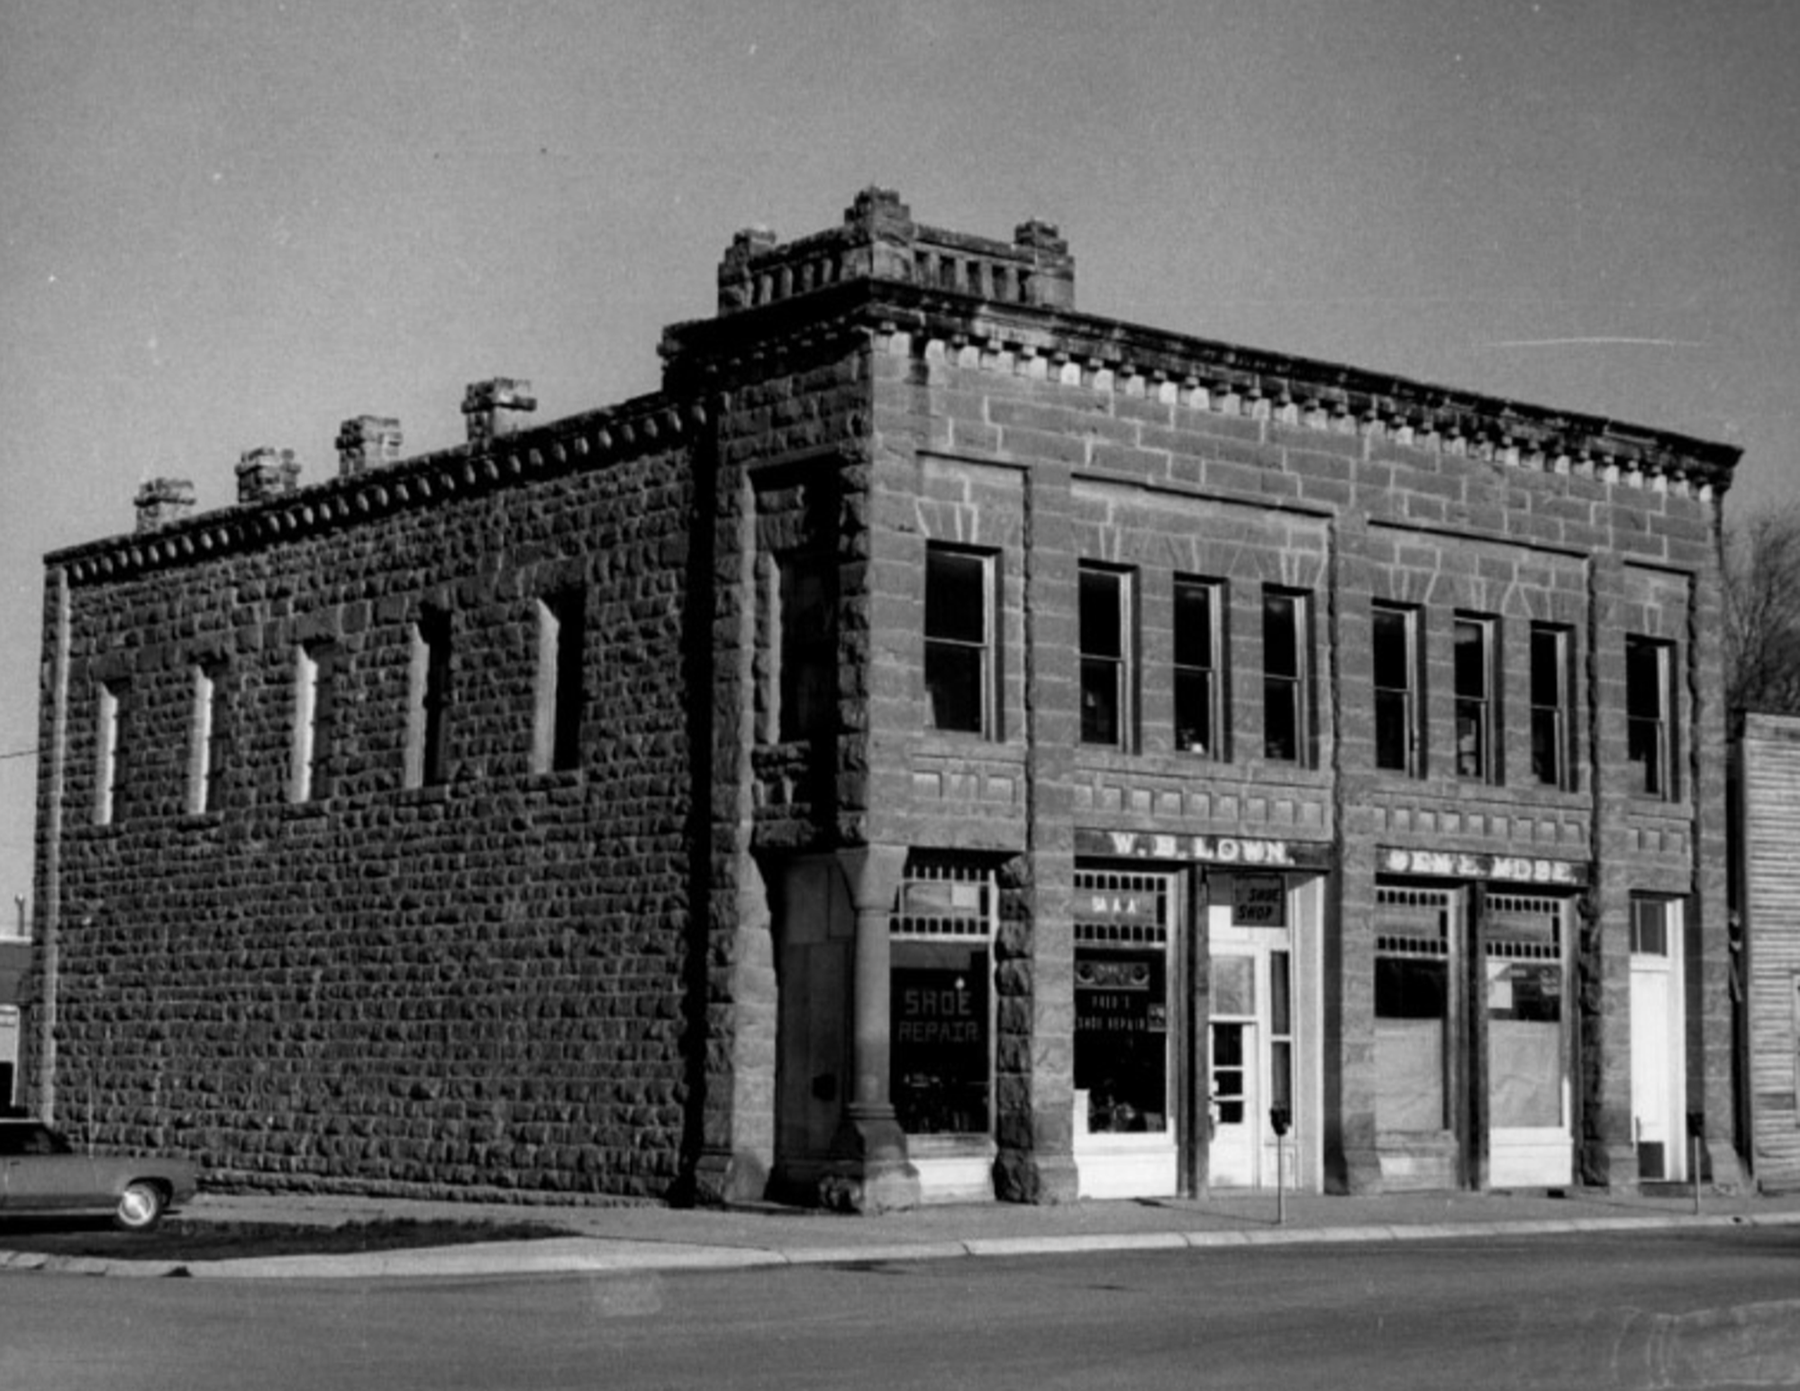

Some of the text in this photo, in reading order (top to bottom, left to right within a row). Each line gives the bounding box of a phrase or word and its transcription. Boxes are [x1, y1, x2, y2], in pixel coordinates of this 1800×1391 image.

[1237, 904, 1272, 920] SHOP
[905, 990, 972, 1016] SHOE
[898, 1021, 978, 1043] REPAIR
